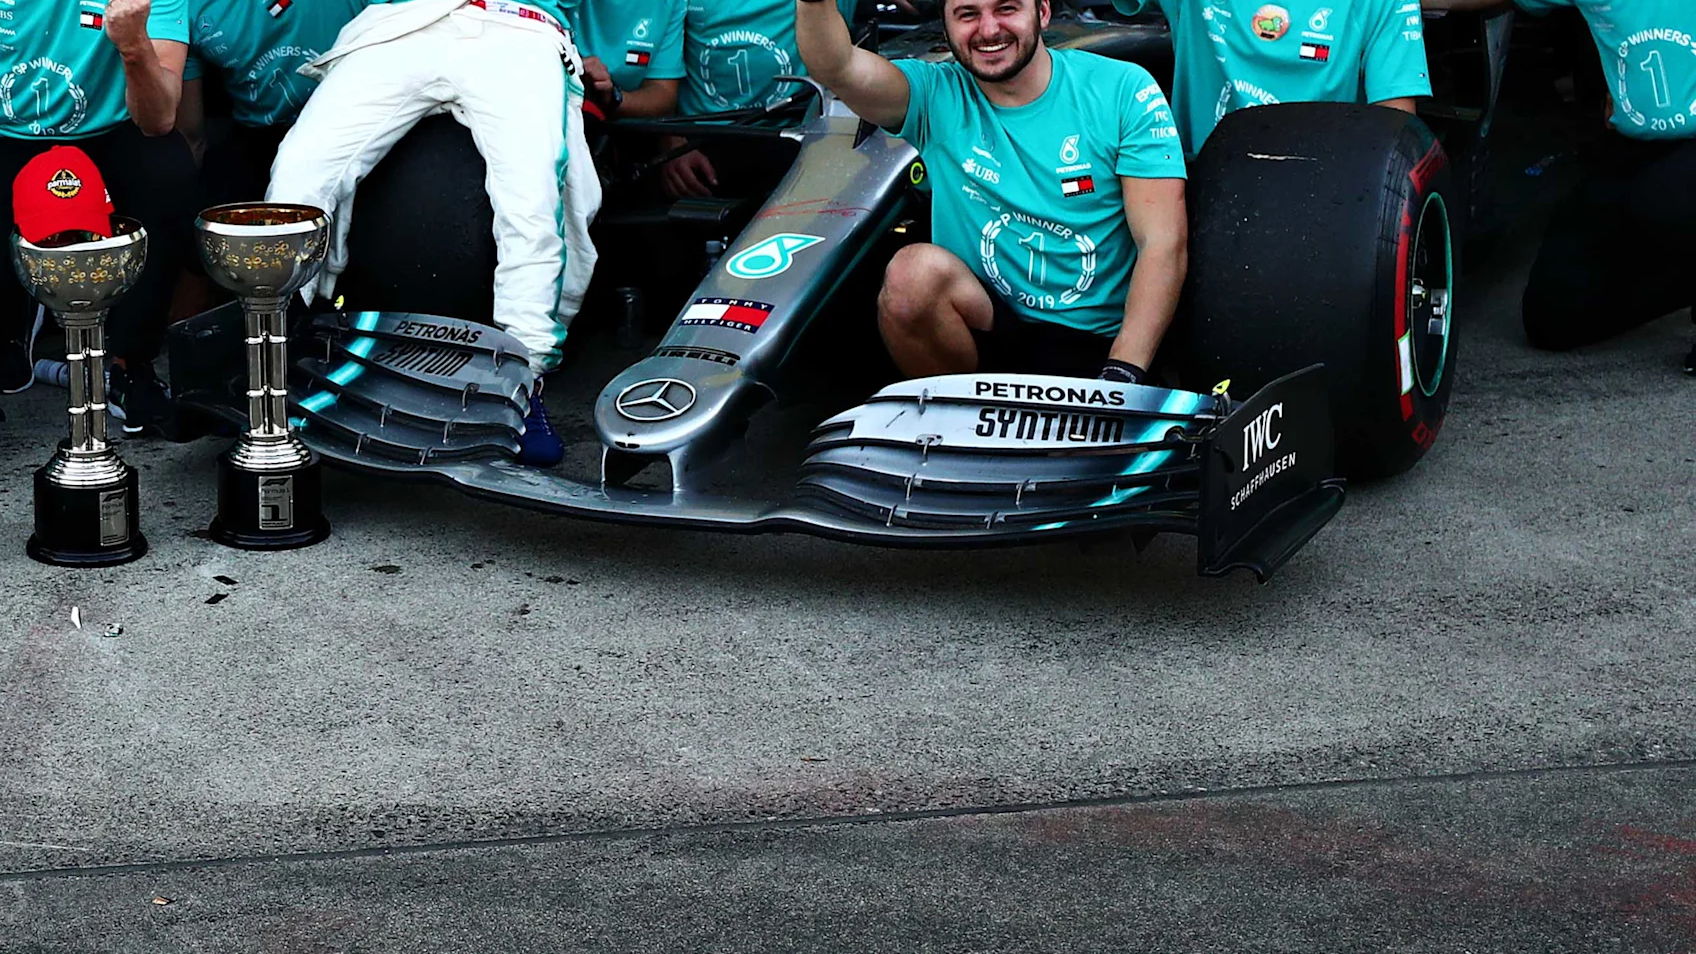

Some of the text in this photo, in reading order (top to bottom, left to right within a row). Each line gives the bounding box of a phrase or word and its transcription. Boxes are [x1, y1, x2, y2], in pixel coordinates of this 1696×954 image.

[720, 30, 776, 50] WINNERS
[1628, 28, 1692, 47] WINNERS
[12, 62, 28, 76] GP
[253, 46, 302, 72] WINNERS
[1650, 112, 1686, 131] 2019
[47, 178, 82, 191] parmalat
[975, 165, 1001, 185] UBS
[1000, 211, 1073, 240] P WINNER
[701, 298, 768, 310] TOMMY
[1018, 291, 1055, 309] 2019
[394, 320, 483, 345] PETRONAS
[684, 319, 752, 331] HILFIGER
[373, 343, 474, 377] SYNTIUM
[975, 381, 1125, 406] PETRONAS
[975, 408, 1125, 443] SYNTIUM
[1242, 402, 1283, 472] IWC
[1230, 451, 1297, 510] SCHAFFHAUSEN
